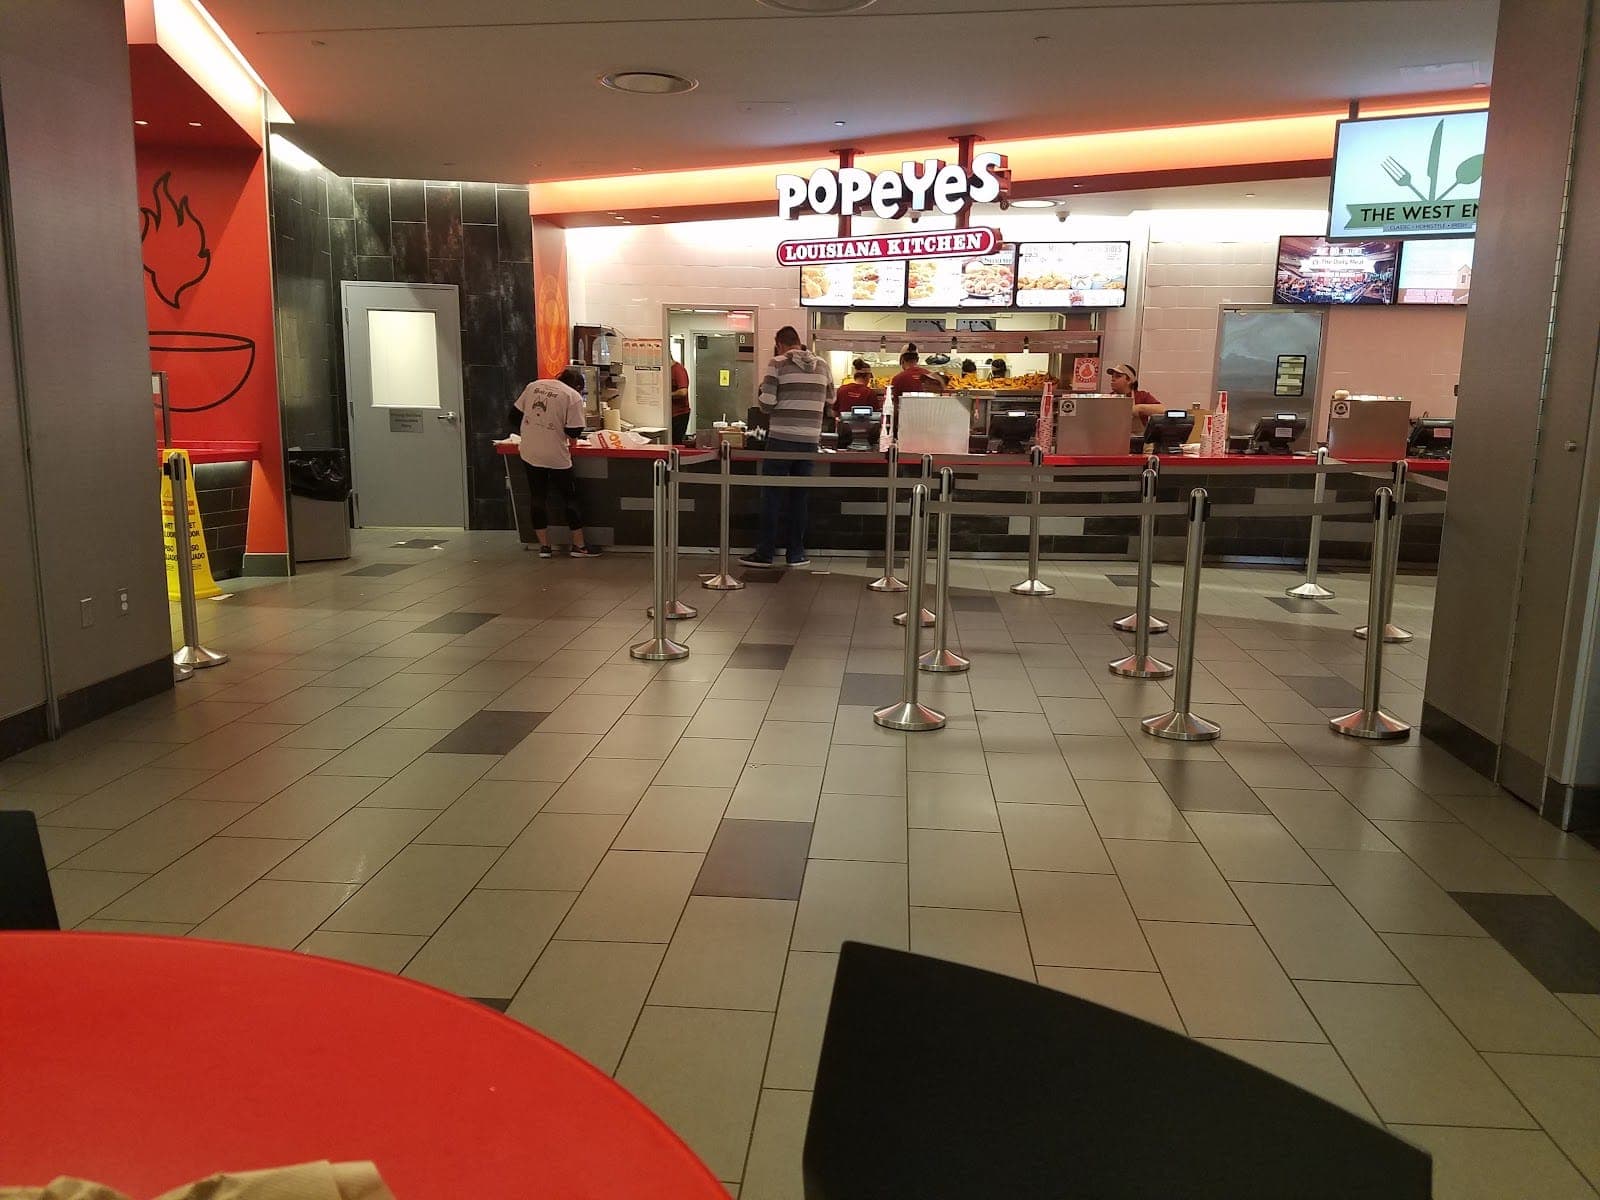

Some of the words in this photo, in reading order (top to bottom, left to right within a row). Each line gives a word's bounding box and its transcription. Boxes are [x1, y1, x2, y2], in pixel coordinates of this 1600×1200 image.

[1361, 207, 1395, 222] THE
[1402, 204, 1455, 220] WEST
[1462, 203, 1479, 218] EN
[784, 239, 882, 261] LOUISIANA
[886, 232, 983, 254] KITCHEN
